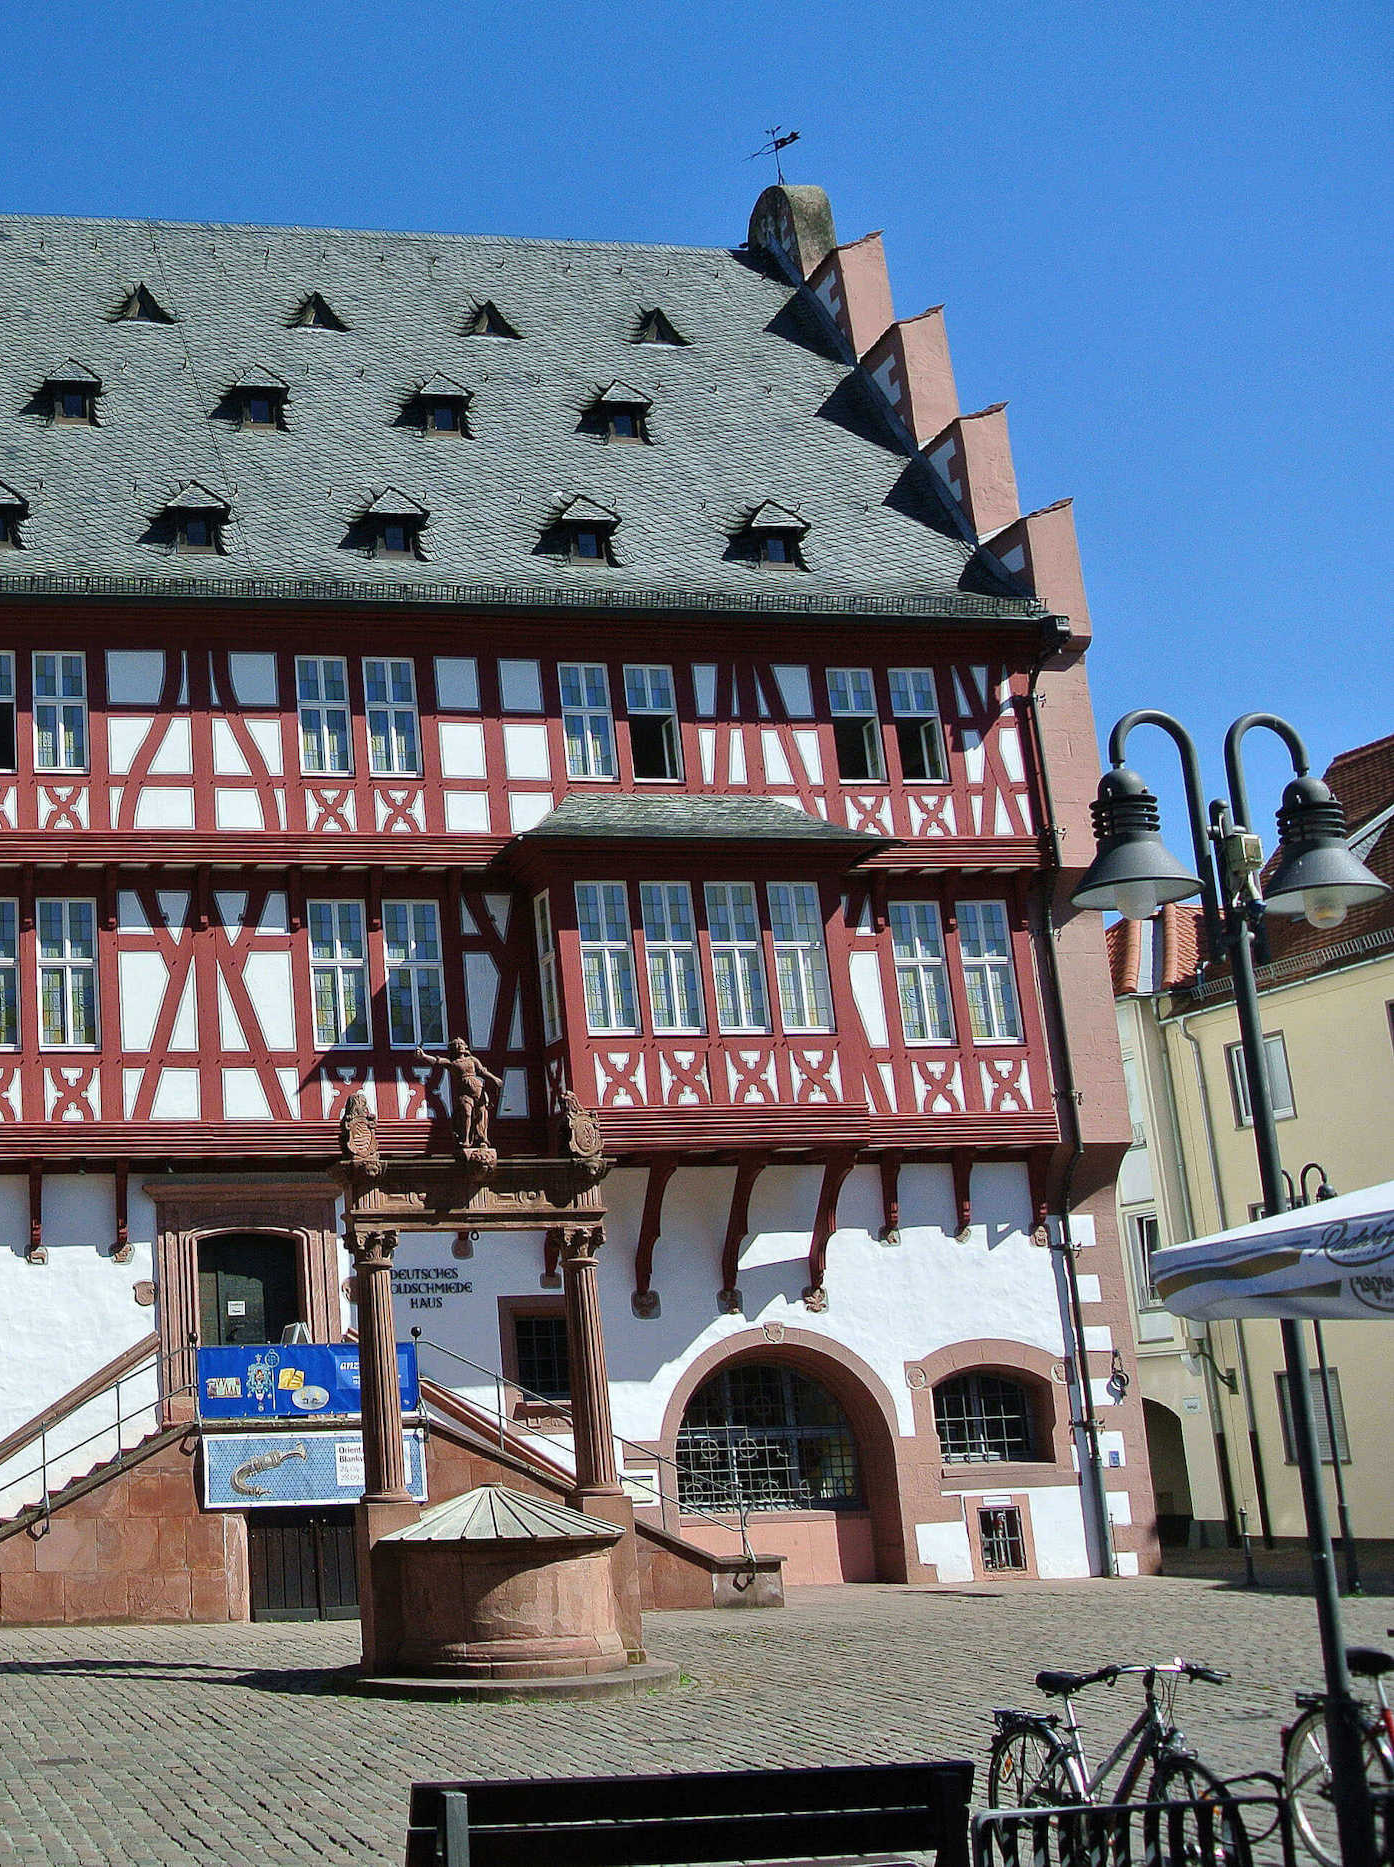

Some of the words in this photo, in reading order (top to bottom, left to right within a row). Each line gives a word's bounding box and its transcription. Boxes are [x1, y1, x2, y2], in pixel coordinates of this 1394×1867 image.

[391, 1268, 459, 1280] DEUTSCHES
[391, 1282, 473, 1294] OLDSCHMIEDE
[410, 1297, 443, 1309] HAUS
[340, 1361, 360, 1371] anz
